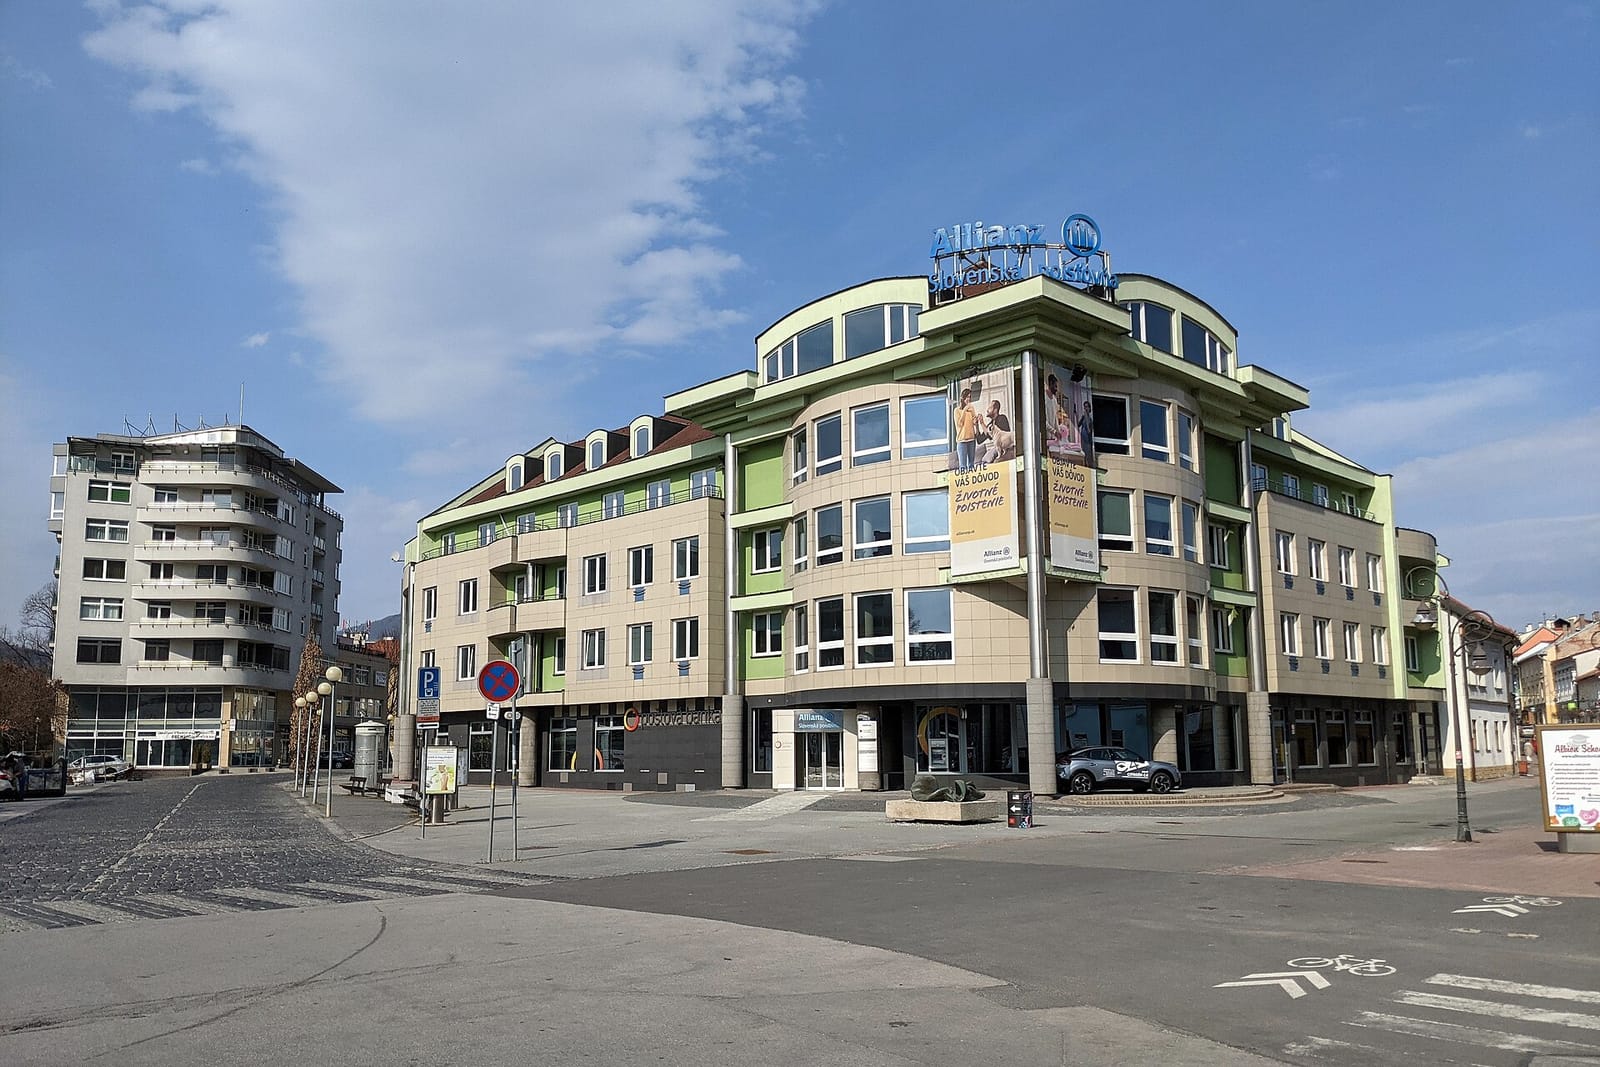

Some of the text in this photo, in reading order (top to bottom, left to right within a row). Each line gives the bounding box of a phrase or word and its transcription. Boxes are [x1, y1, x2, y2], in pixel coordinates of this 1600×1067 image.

[929, 221, 1046, 258] Allianz
[929, 265, 1022, 293] Slovenská
[955, 471, 999, 488] VÁŠ DÔVOD
[1052, 466, 1085, 483] VÁŠ DÔVOD
[955, 482, 999, 503] ŽIVOTNÉ
[1052, 480, 1085, 498] ŽIVOTNÉ
[955, 495, 1005, 515] POISTENIE
[1053, 494, 1089, 509] POISTENIE
[984, 550, 1002, 558] Allianz
[424, 671, 434, 689] P
[798, 713, 824, 721] Allianz
